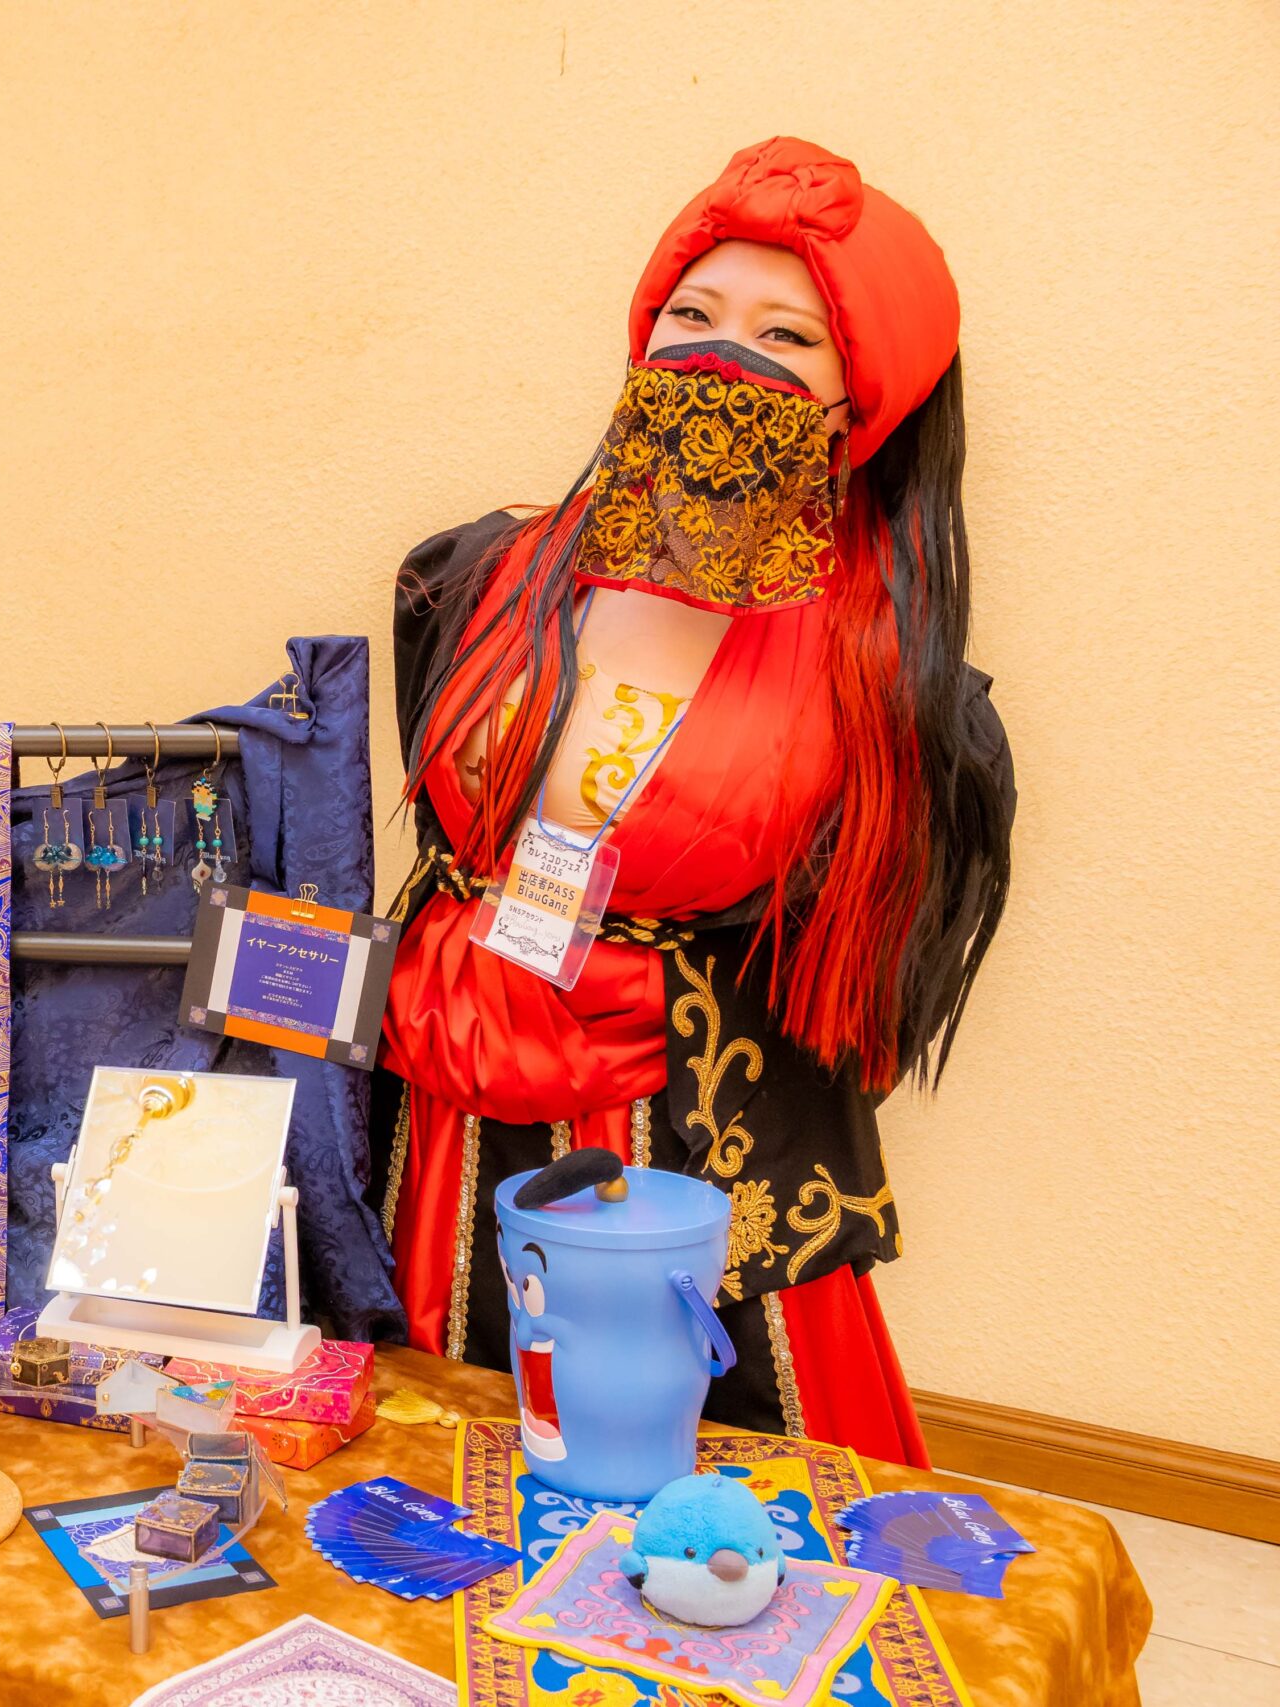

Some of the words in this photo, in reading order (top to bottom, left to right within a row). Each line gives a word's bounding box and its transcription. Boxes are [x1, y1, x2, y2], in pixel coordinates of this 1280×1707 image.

[527, 847, 581, 873] カレスコDフェス
[540, 863, 563, 877] 2025
[518, 870, 576, 901] 出店者PASS
[508, 905, 544, 923] SNSアカウント
[517, 886, 569, 915] BlauGang
[246, 936, 340, 964] イヤーアクセサリー
[365, 1485, 404, 1504] Blau
[402, 1502, 445, 1521] Gang
[942, 1496, 973, 1520] Blau
[964, 1521, 998, 1546] Gang
